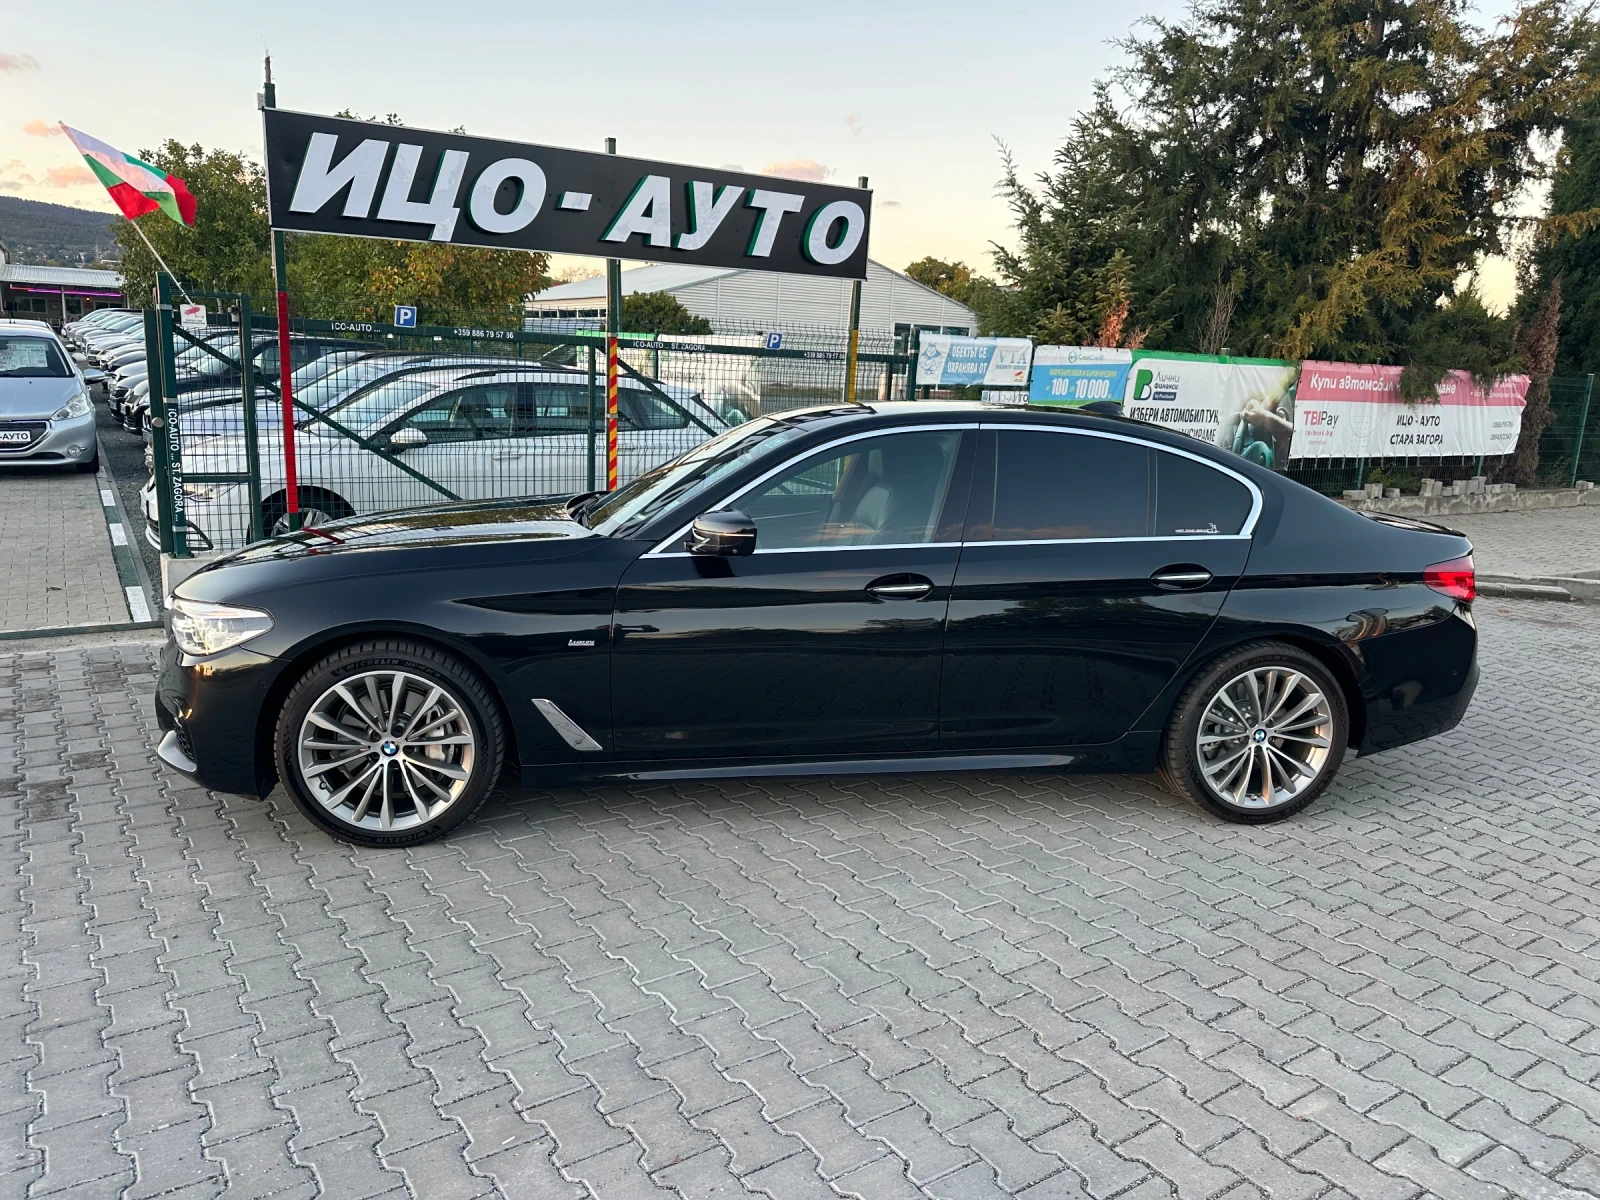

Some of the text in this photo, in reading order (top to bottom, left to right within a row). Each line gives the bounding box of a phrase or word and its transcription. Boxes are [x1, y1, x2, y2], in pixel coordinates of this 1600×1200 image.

[289, 131, 546, 242] ИЦО
[601, 174, 865, 266] АУТО
[400, 309, 411, 324] P
[485, 330, 495, 338] 79
[769, 334, 780, 347] P
[952, 346, 988, 359] ОБЕКТЪТ СЕ
[998, 349, 1027, 364] VTA
[947, 362, 988, 374] ОХРАНЯВА ОТ
[1155, 371, 1180, 383] Лични
[1310, 373, 1337, 391] Купи
[1052, 378, 1069, 396] 100
[1129, 406, 1160, 422] ИЗБЕРИ
[1160, 408, 1204, 423] АВТОМОБИЛ
[1396, 414, 1414, 427] ИЦО
[1420, 415, 1441, 427] АУТО
[1389, 434, 1443, 445] СТАРА ЗАГОРА
[172, 477, 184, 513] ZAGORA
